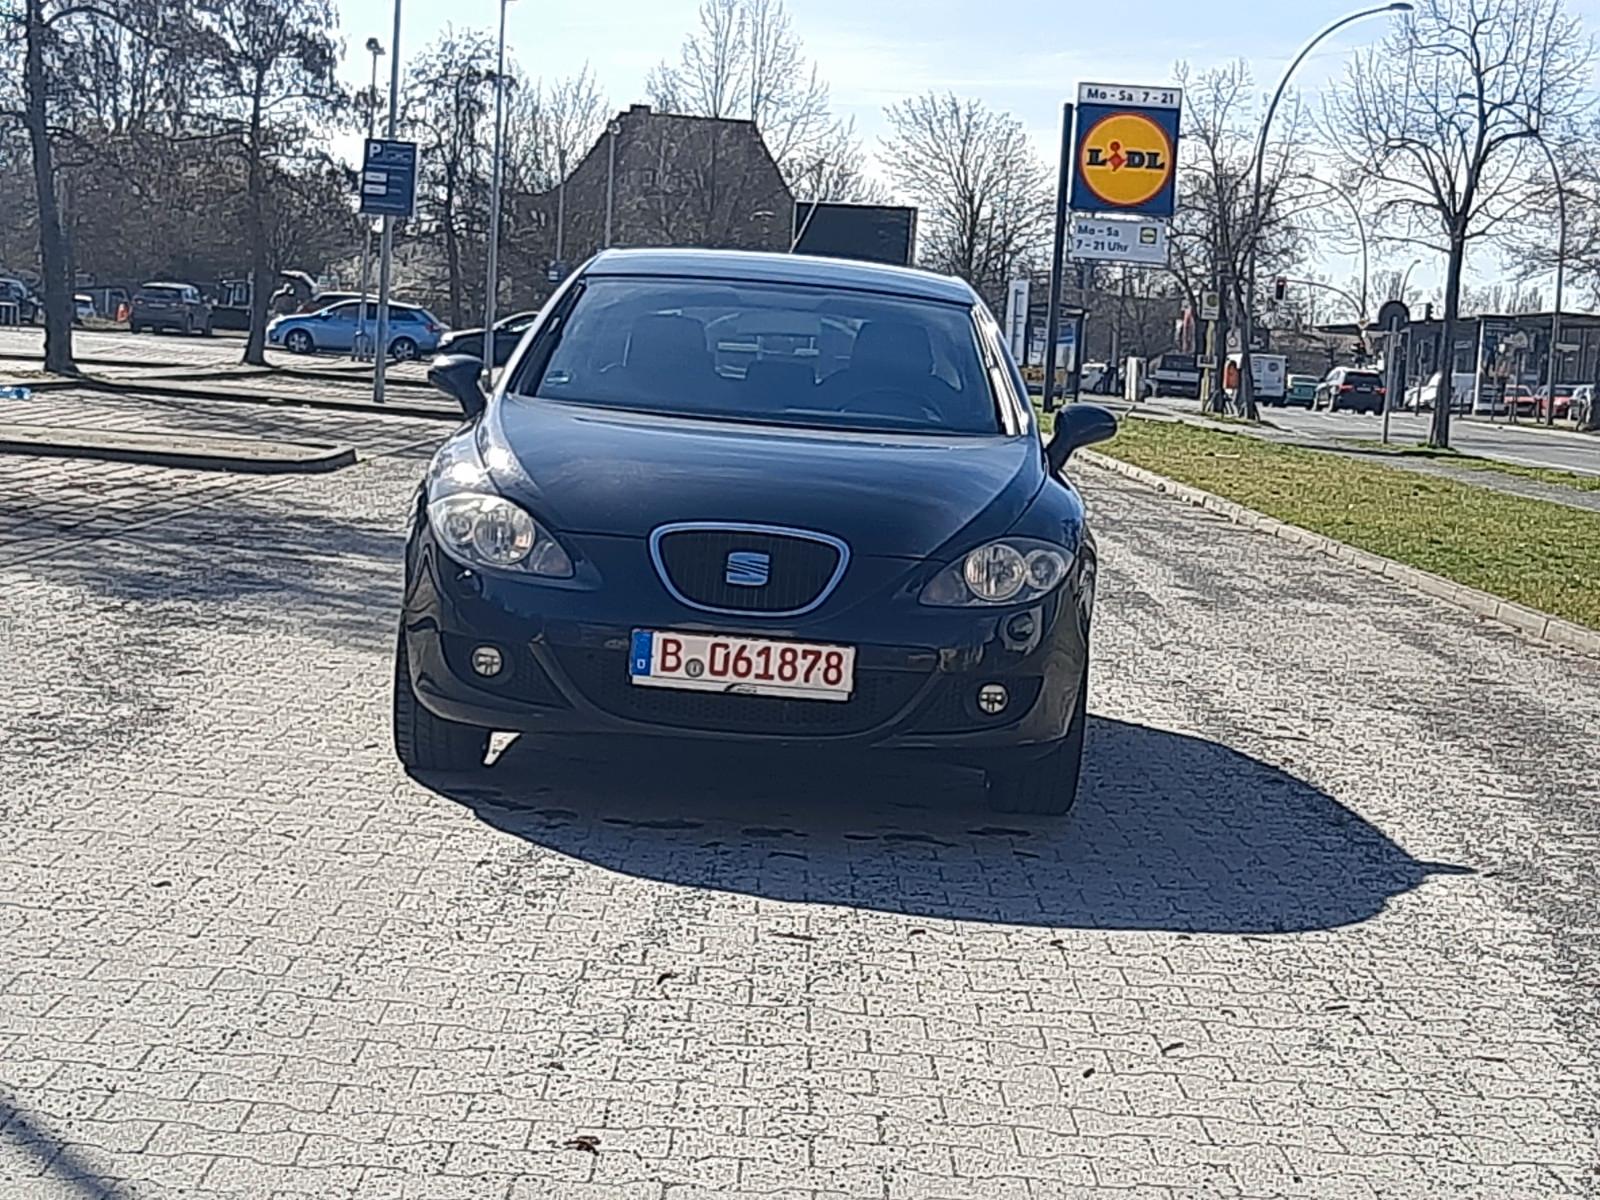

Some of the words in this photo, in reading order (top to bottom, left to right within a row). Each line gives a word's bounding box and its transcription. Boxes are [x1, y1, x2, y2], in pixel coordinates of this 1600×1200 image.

[1087, 88, 1107, 99] Mo
[1118, 90, 1133, 101] Sa
[1142, 91, 1150, 102] 7
[1161, 92, 1174, 104] 21
[369, 143, 382, 158] P
[1077, 225, 1095, 235] Mo
[1106, 227, 1119, 237] Sa
[1076, 240, 1083, 249] 7
[1093, 240, 1105, 251] 21
[1107, 241, 1128, 252] Uhr
[660, 638, 682, 672] B
[709, 642, 844, 686] 061878
